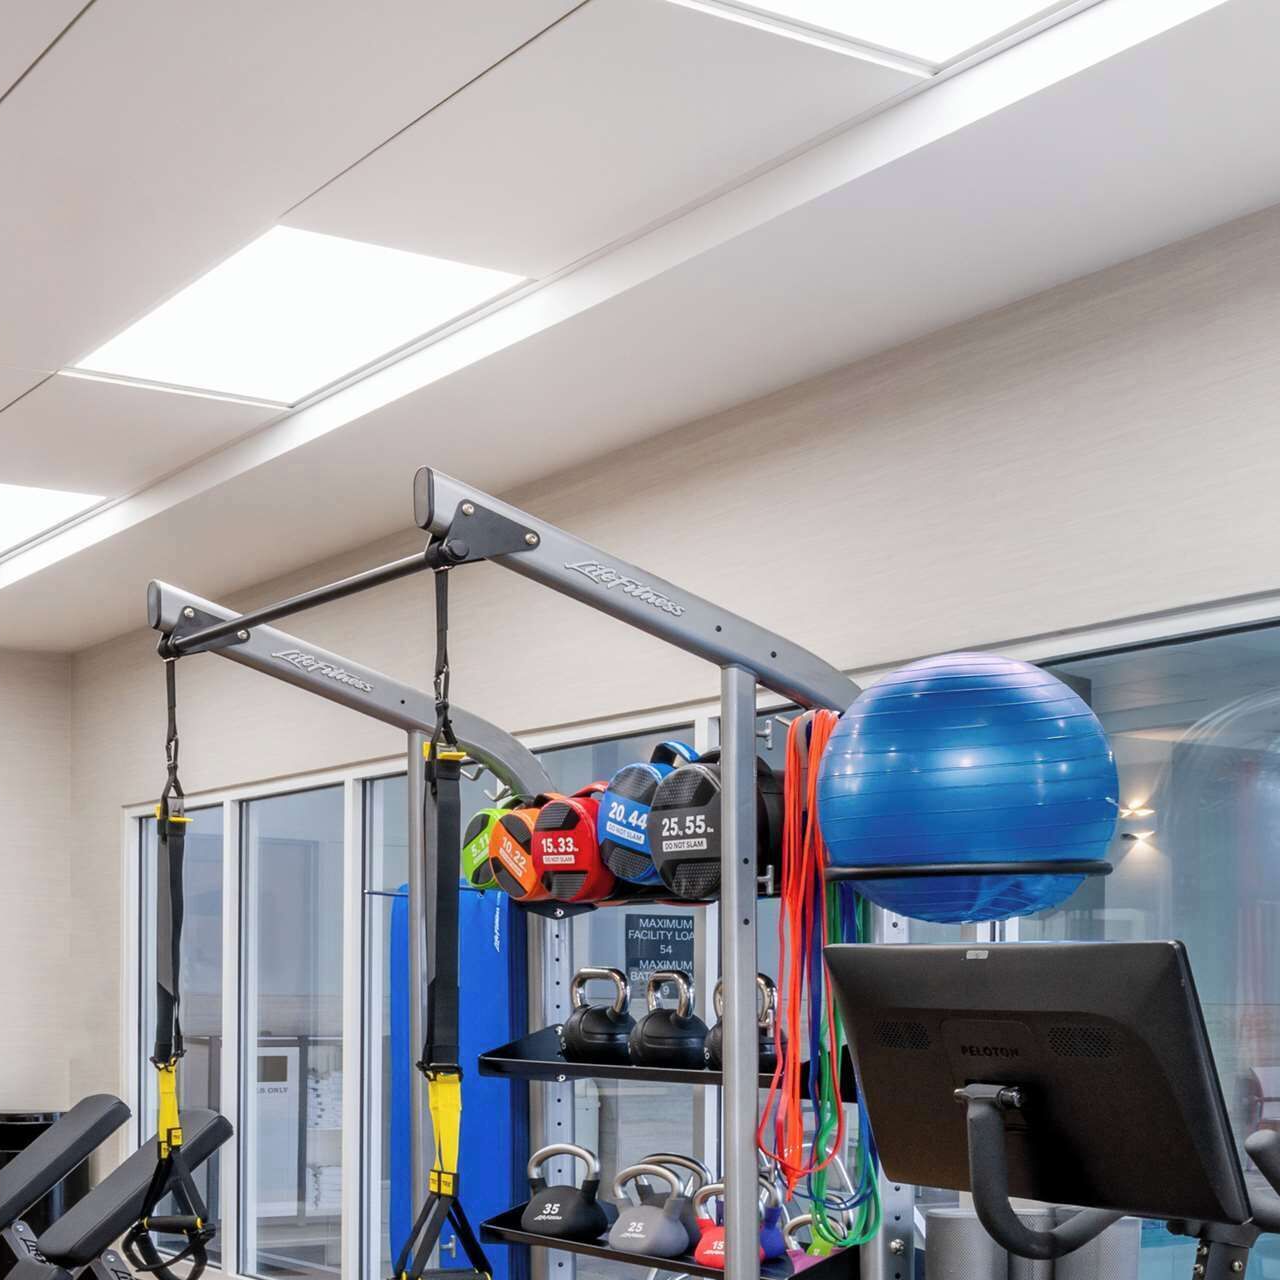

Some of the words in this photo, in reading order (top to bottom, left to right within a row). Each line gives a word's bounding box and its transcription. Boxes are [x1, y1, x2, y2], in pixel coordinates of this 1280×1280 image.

[639, 918, 693, 928] MAXIMUM
[628, 929, 673, 940] FACILITY
[675, 930, 695, 941] LOA
[659, 944, 672, 954] 54
[639, 959, 693, 970] MAXIMUM
[960, 1045, 1019, 1058] PELOTON
[542, 1203, 561, 1215] 35
[627, 1222, 644, 1233] 25
